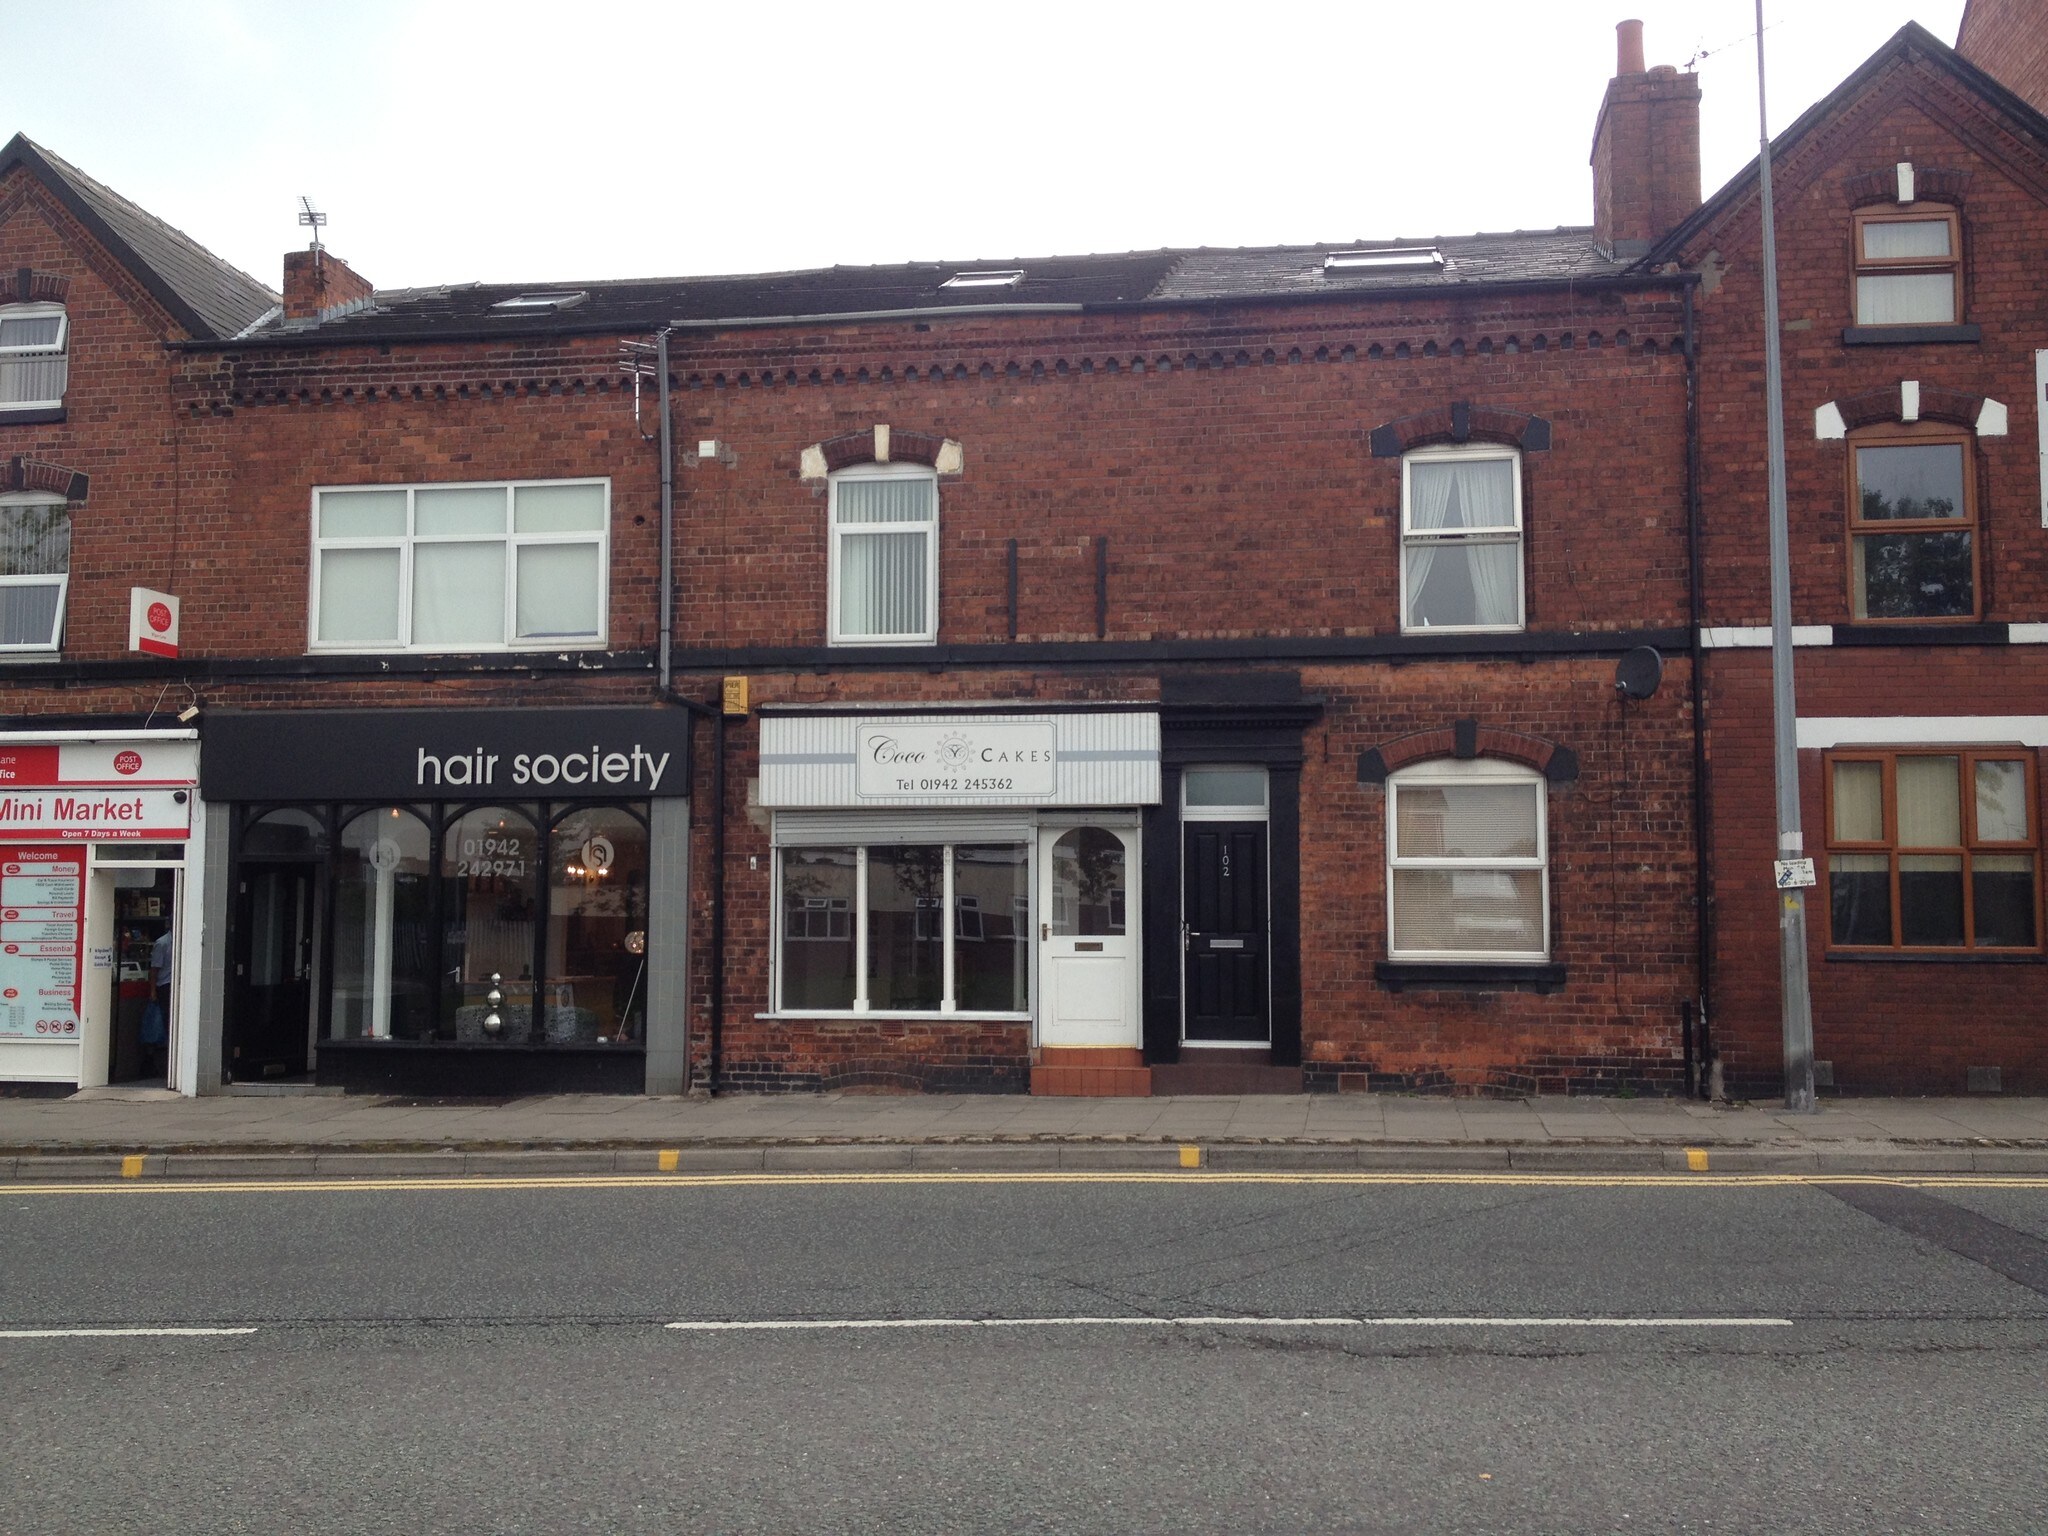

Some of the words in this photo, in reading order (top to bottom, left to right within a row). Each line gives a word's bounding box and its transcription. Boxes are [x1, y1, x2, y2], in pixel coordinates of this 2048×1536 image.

[867, 735, 928, 765] Coco
[981, 747, 1051, 762] CAKES
[0, 756, 16, 764] ane
[116, 762, 140, 770] OFFICE
[417, 747, 499, 785] hair
[512, 744, 670, 791] society
[896, 779, 914, 790] Tel
[920, 779, 958, 790] 01942
[964, 778, 1013, 790] 245362
[54, 797, 144, 821] Market
[62, 830, 82, 838] Open
[91, 830, 111, 838] Days
[464, 838, 520, 856] 01942
[18, 852, 58, 860] Welcome
[1222, 845, 1230, 877] 102
[457, 860, 525, 877] 242971
[40, 944, 73, 952] Essential
[38, 988, 71, 996] Business
